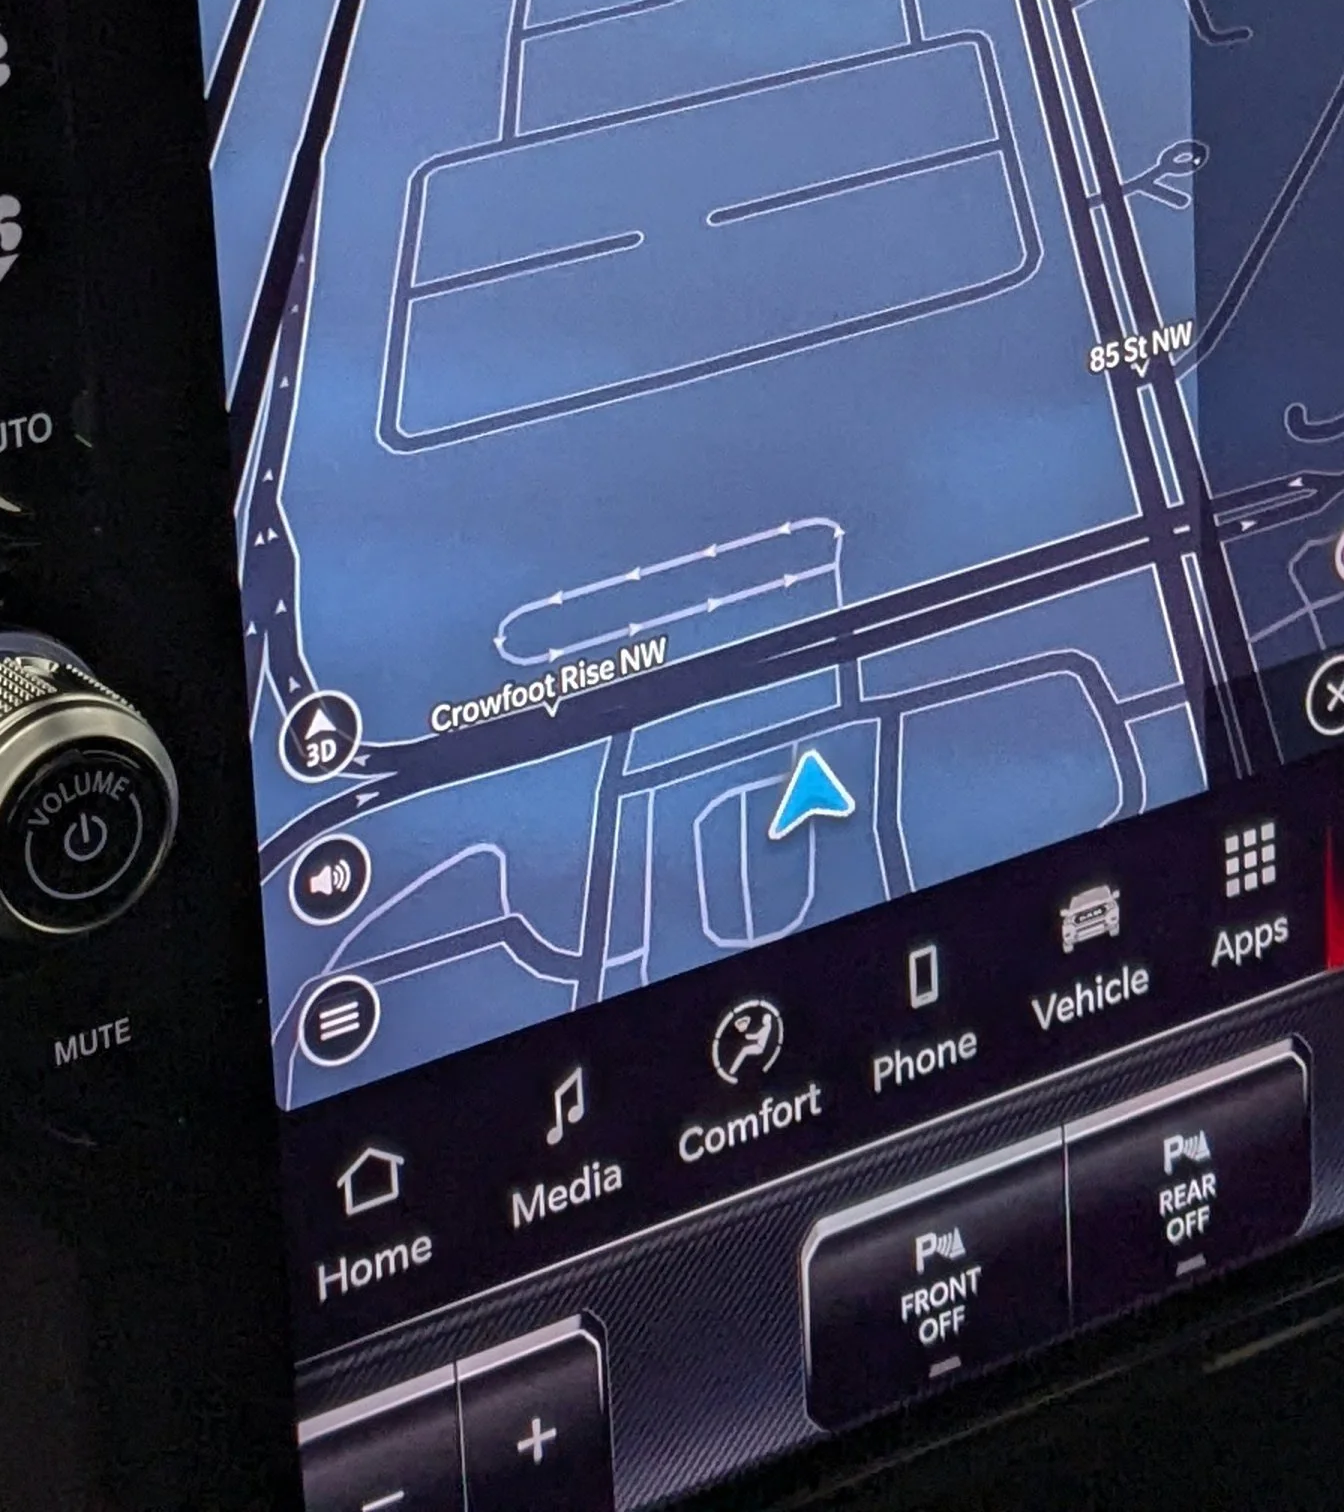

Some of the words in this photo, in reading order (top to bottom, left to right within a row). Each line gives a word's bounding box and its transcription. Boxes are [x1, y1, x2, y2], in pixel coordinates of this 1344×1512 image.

[1090, 344, 1120, 372] 85
[1123, 337, 1149, 364] St
[1151, 322, 1193, 352] NW
[430, 673, 556, 734] Crowfoot
[560, 656, 616, 693] Rise
[619, 637, 667, 675] NW
[306, 739, 337, 767] 3D
[27, 770, 131, 829] VOLUME
[1211, 915, 1289, 968] Apps
[1032, 965, 1150, 1031] Vehicle
[54, 1017, 132, 1067] MUTE
[873, 1030, 978, 1092] Phone
[678, 1086, 823, 1165] Comfort
[511, 1160, 623, 1228] Media
[1159, 1172, 1217, 1218] REAR
[1166, 1210, 1211, 1246] OFF
[317, 1231, 433, 1303] Home
[901, 1268, 981, 1323] FRONT
[919, 1309, 966, 1346] OFF
